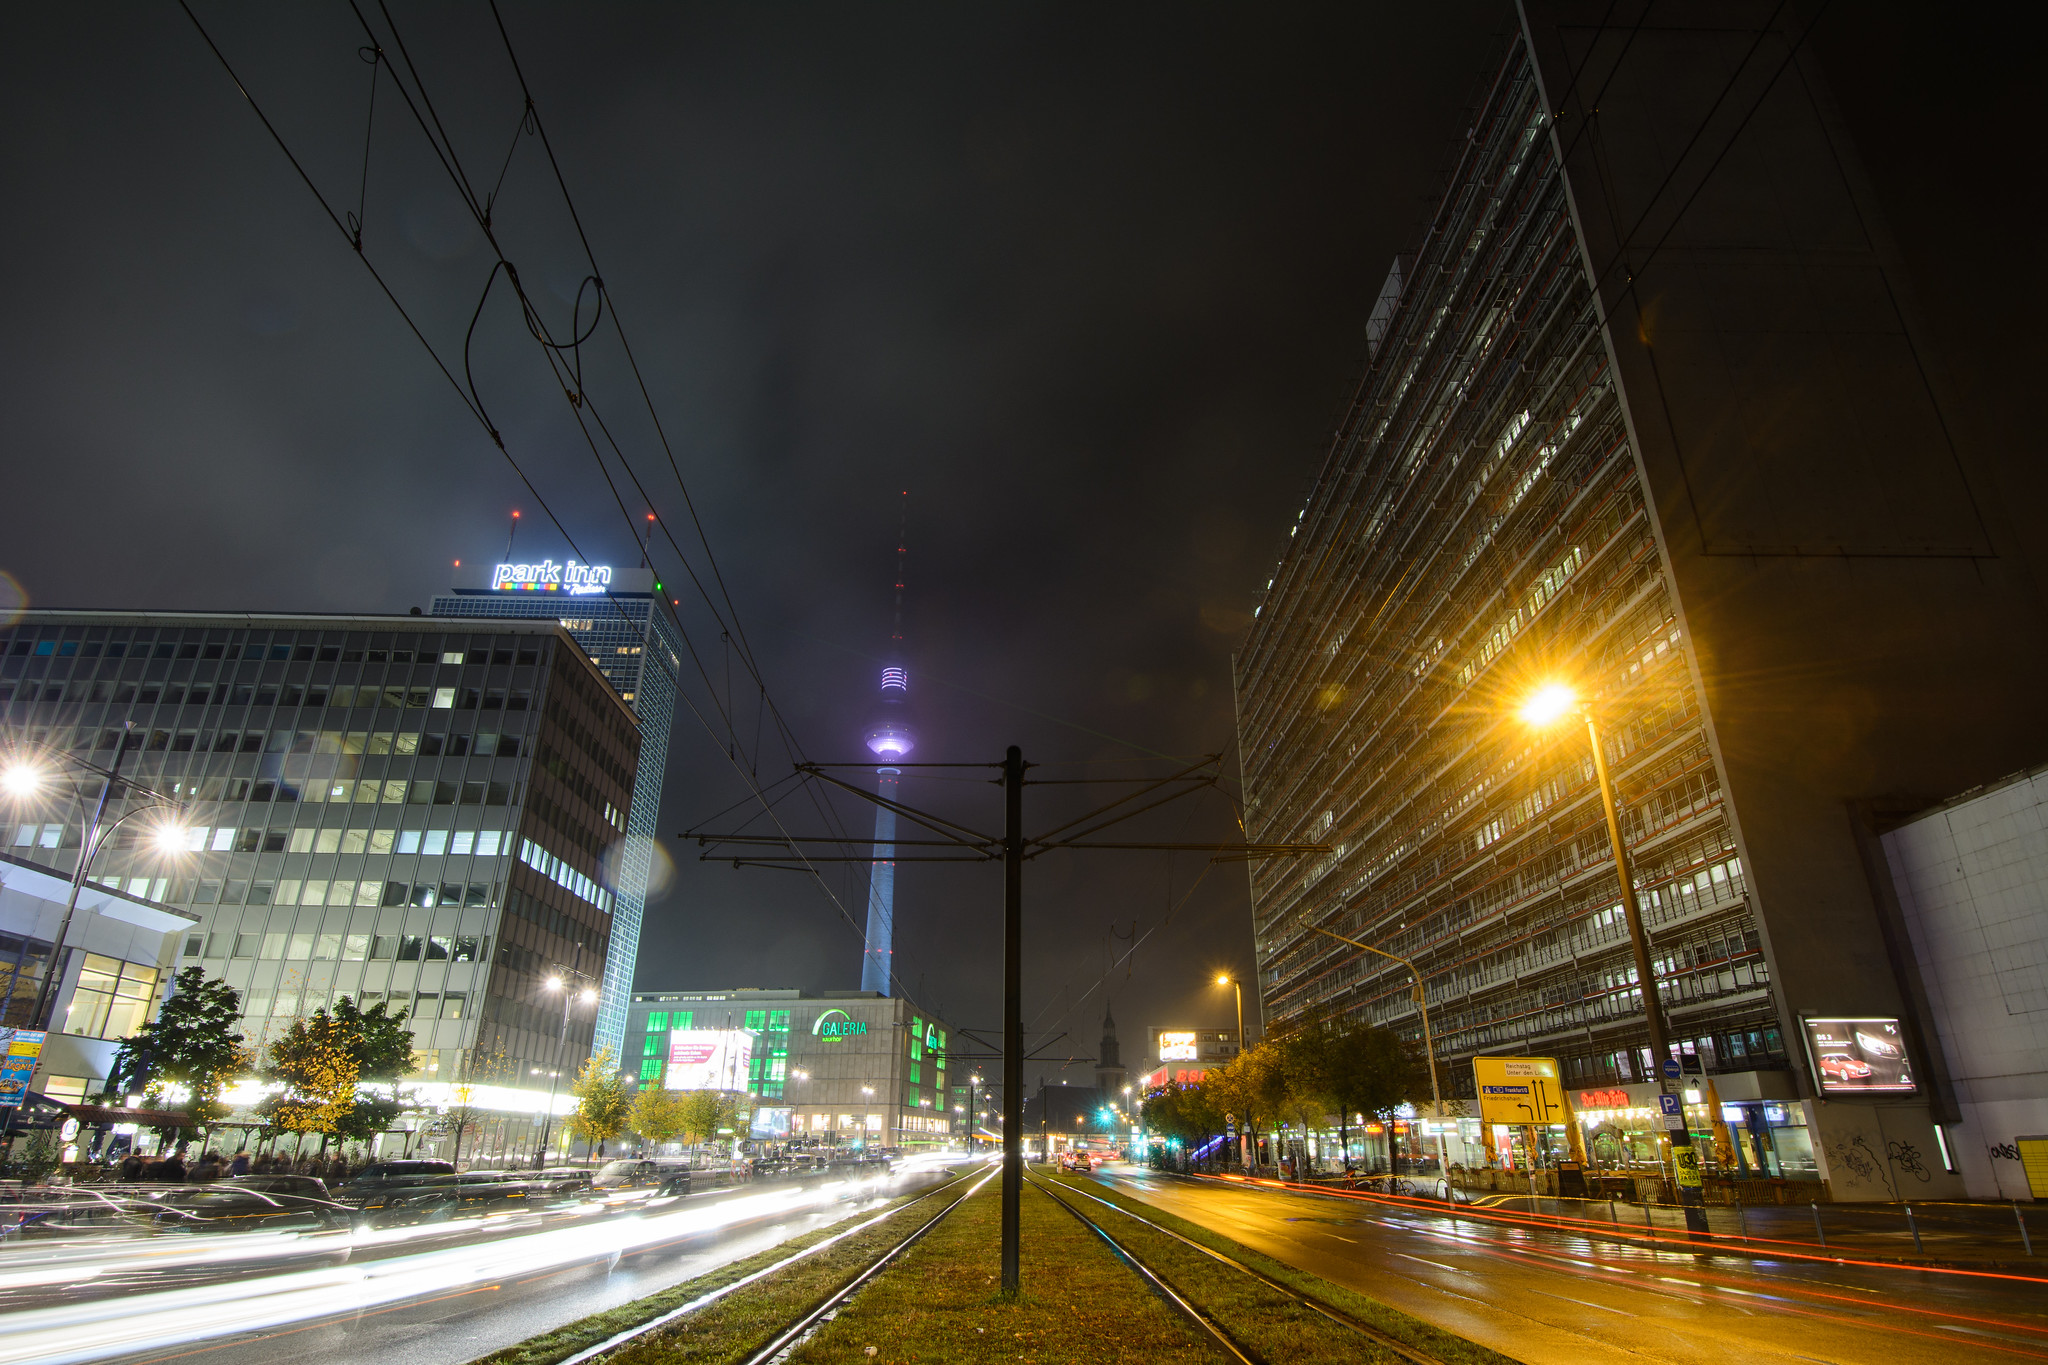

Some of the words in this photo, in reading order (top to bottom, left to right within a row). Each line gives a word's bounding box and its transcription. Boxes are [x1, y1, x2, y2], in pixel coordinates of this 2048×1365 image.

[492, 560, 561, 590] park
[565, 560, 611, 583] inn
[822, 1022, 867, 1036] GALERIA
[4, 1060, 33, 1072] KRONE
[1663, 1097, 1674, 1112] P
